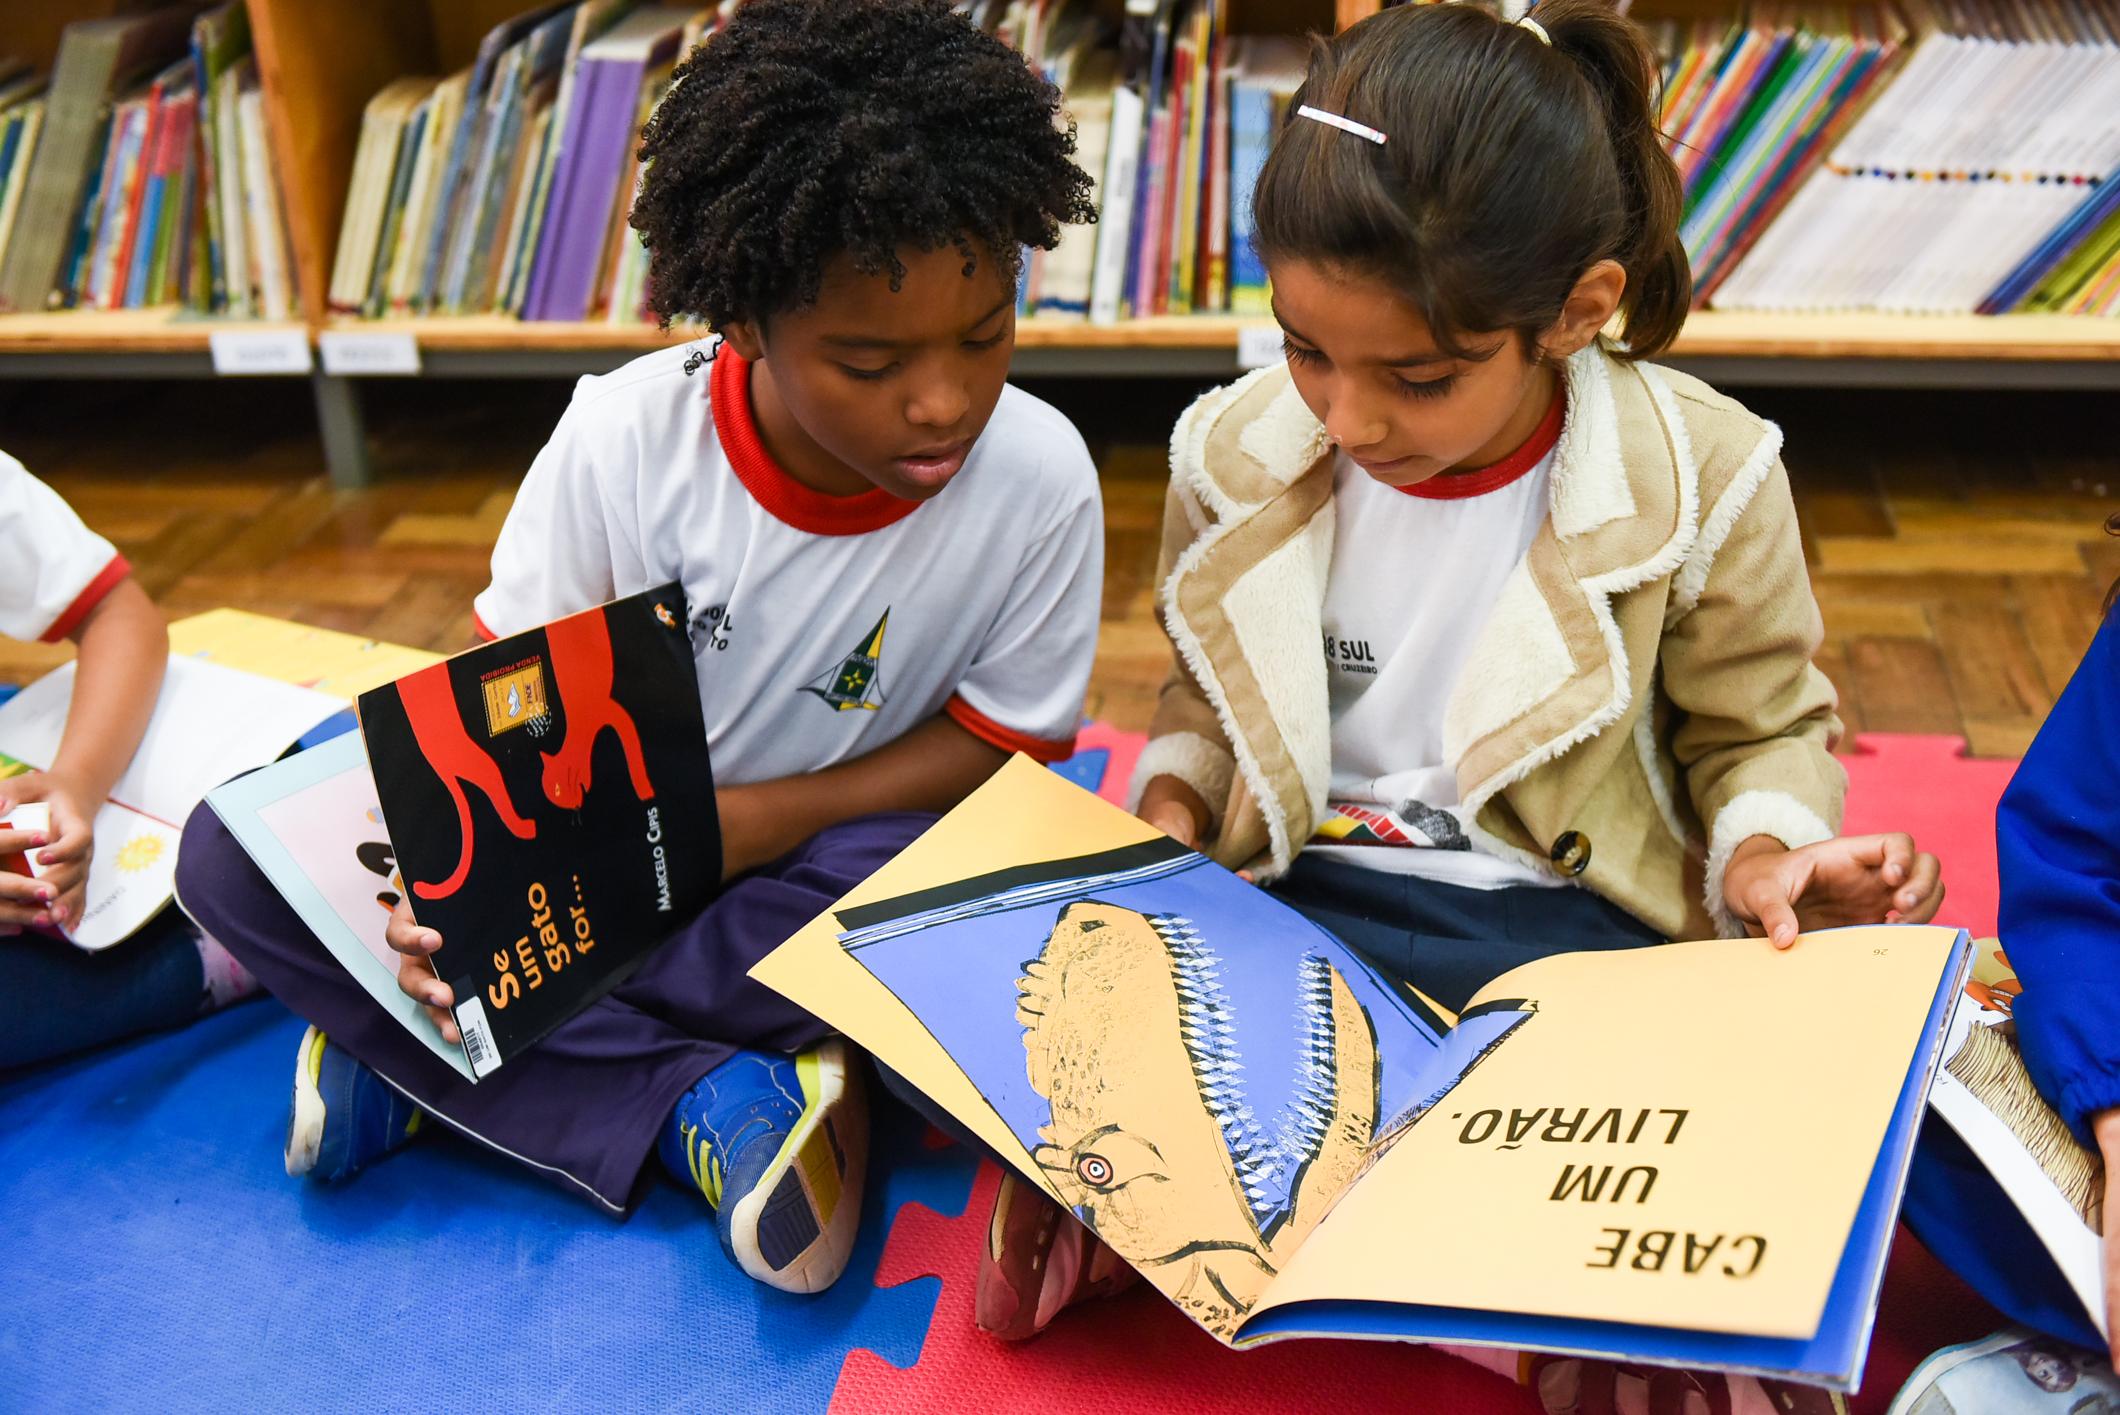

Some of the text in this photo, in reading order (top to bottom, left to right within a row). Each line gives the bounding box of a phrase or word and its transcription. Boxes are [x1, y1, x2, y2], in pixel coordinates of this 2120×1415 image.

[480, 664, 516, 682] PROIBIDA
[1339, 640, 1376, 662] SUL
[1340, 663, 1378, 675] CRUZEIRO
[646, 807, 671, 912] MARCELO CIPIS
[528, 882, 571, 972] gato
[489, 948, 521, 1010] Se
[515, 935, 543, 990] um
[1451, 1107, 1690, 1151] LIVRÃO.
[1549, 1164, 1659, 1204] UM
[1586, 1226, 1769, 1279] CABE
